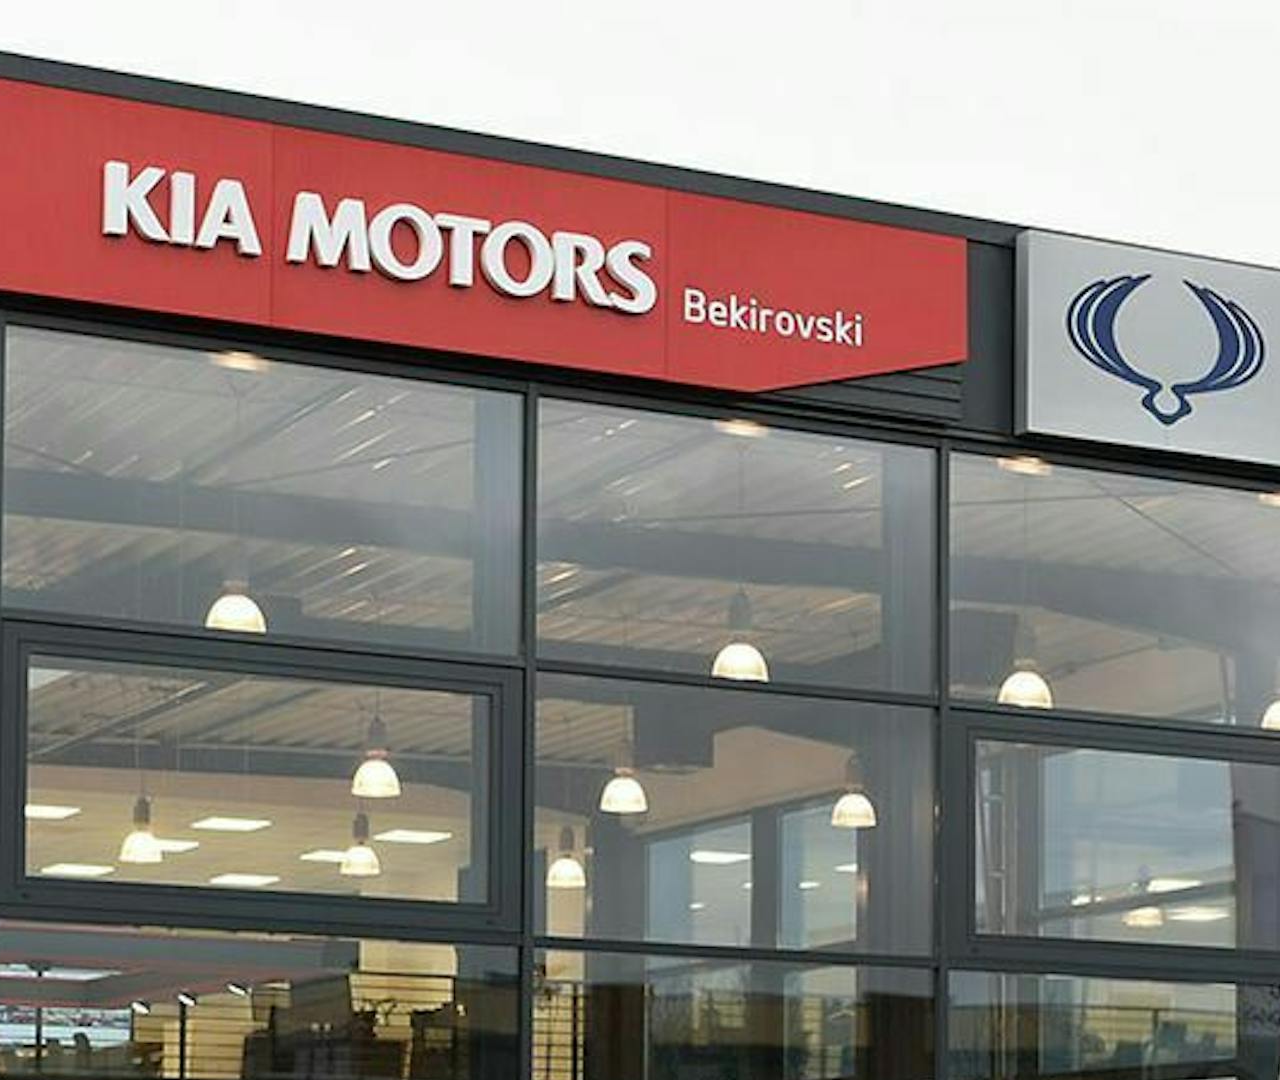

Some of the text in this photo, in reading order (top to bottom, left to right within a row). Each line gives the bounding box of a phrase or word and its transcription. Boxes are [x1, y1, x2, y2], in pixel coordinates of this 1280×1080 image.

[103, 160, 656, 312] KIA MOTORS
[685, 289, 861, 346] Bekirovski
